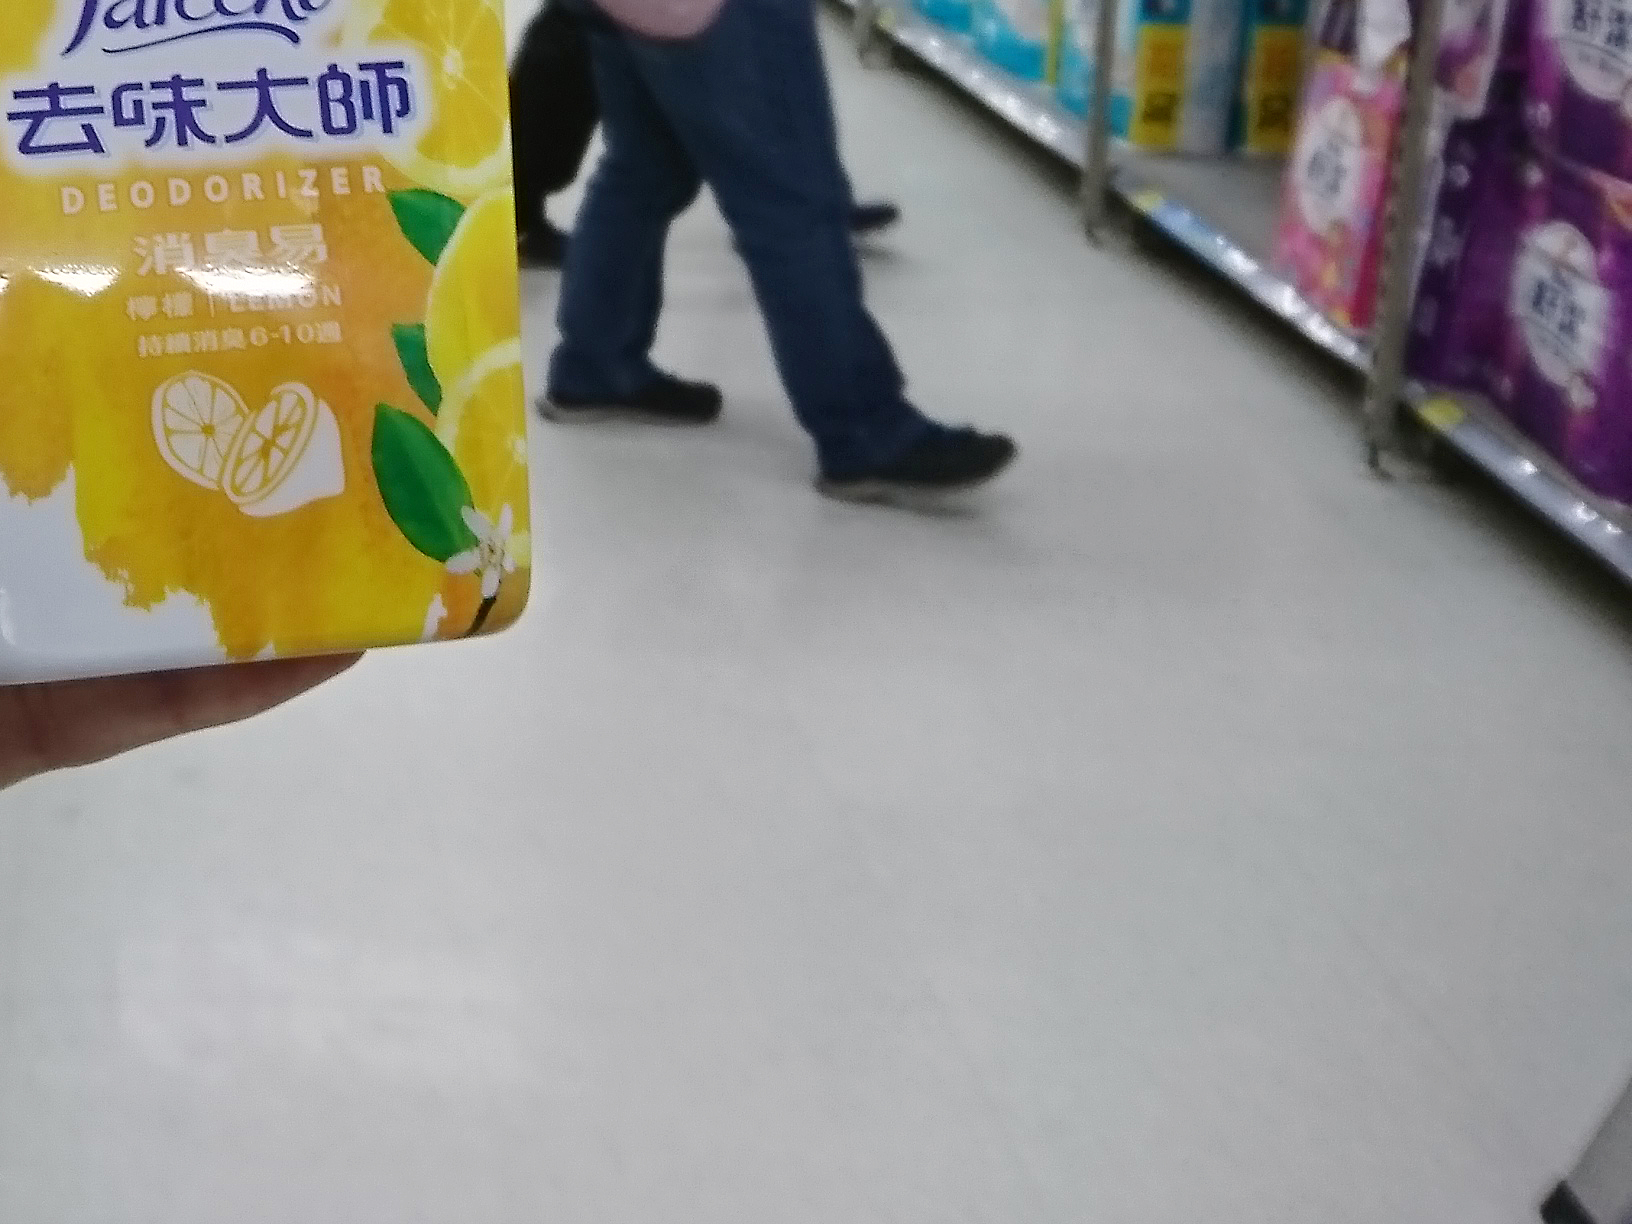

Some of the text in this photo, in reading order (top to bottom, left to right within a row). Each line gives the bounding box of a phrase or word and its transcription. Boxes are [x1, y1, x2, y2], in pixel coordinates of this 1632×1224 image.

[6, 60, 411, 158] 去味大師
[60, 165, 388, 216] DEODORIZER
[133, 223, 329, 277] 消臭易
